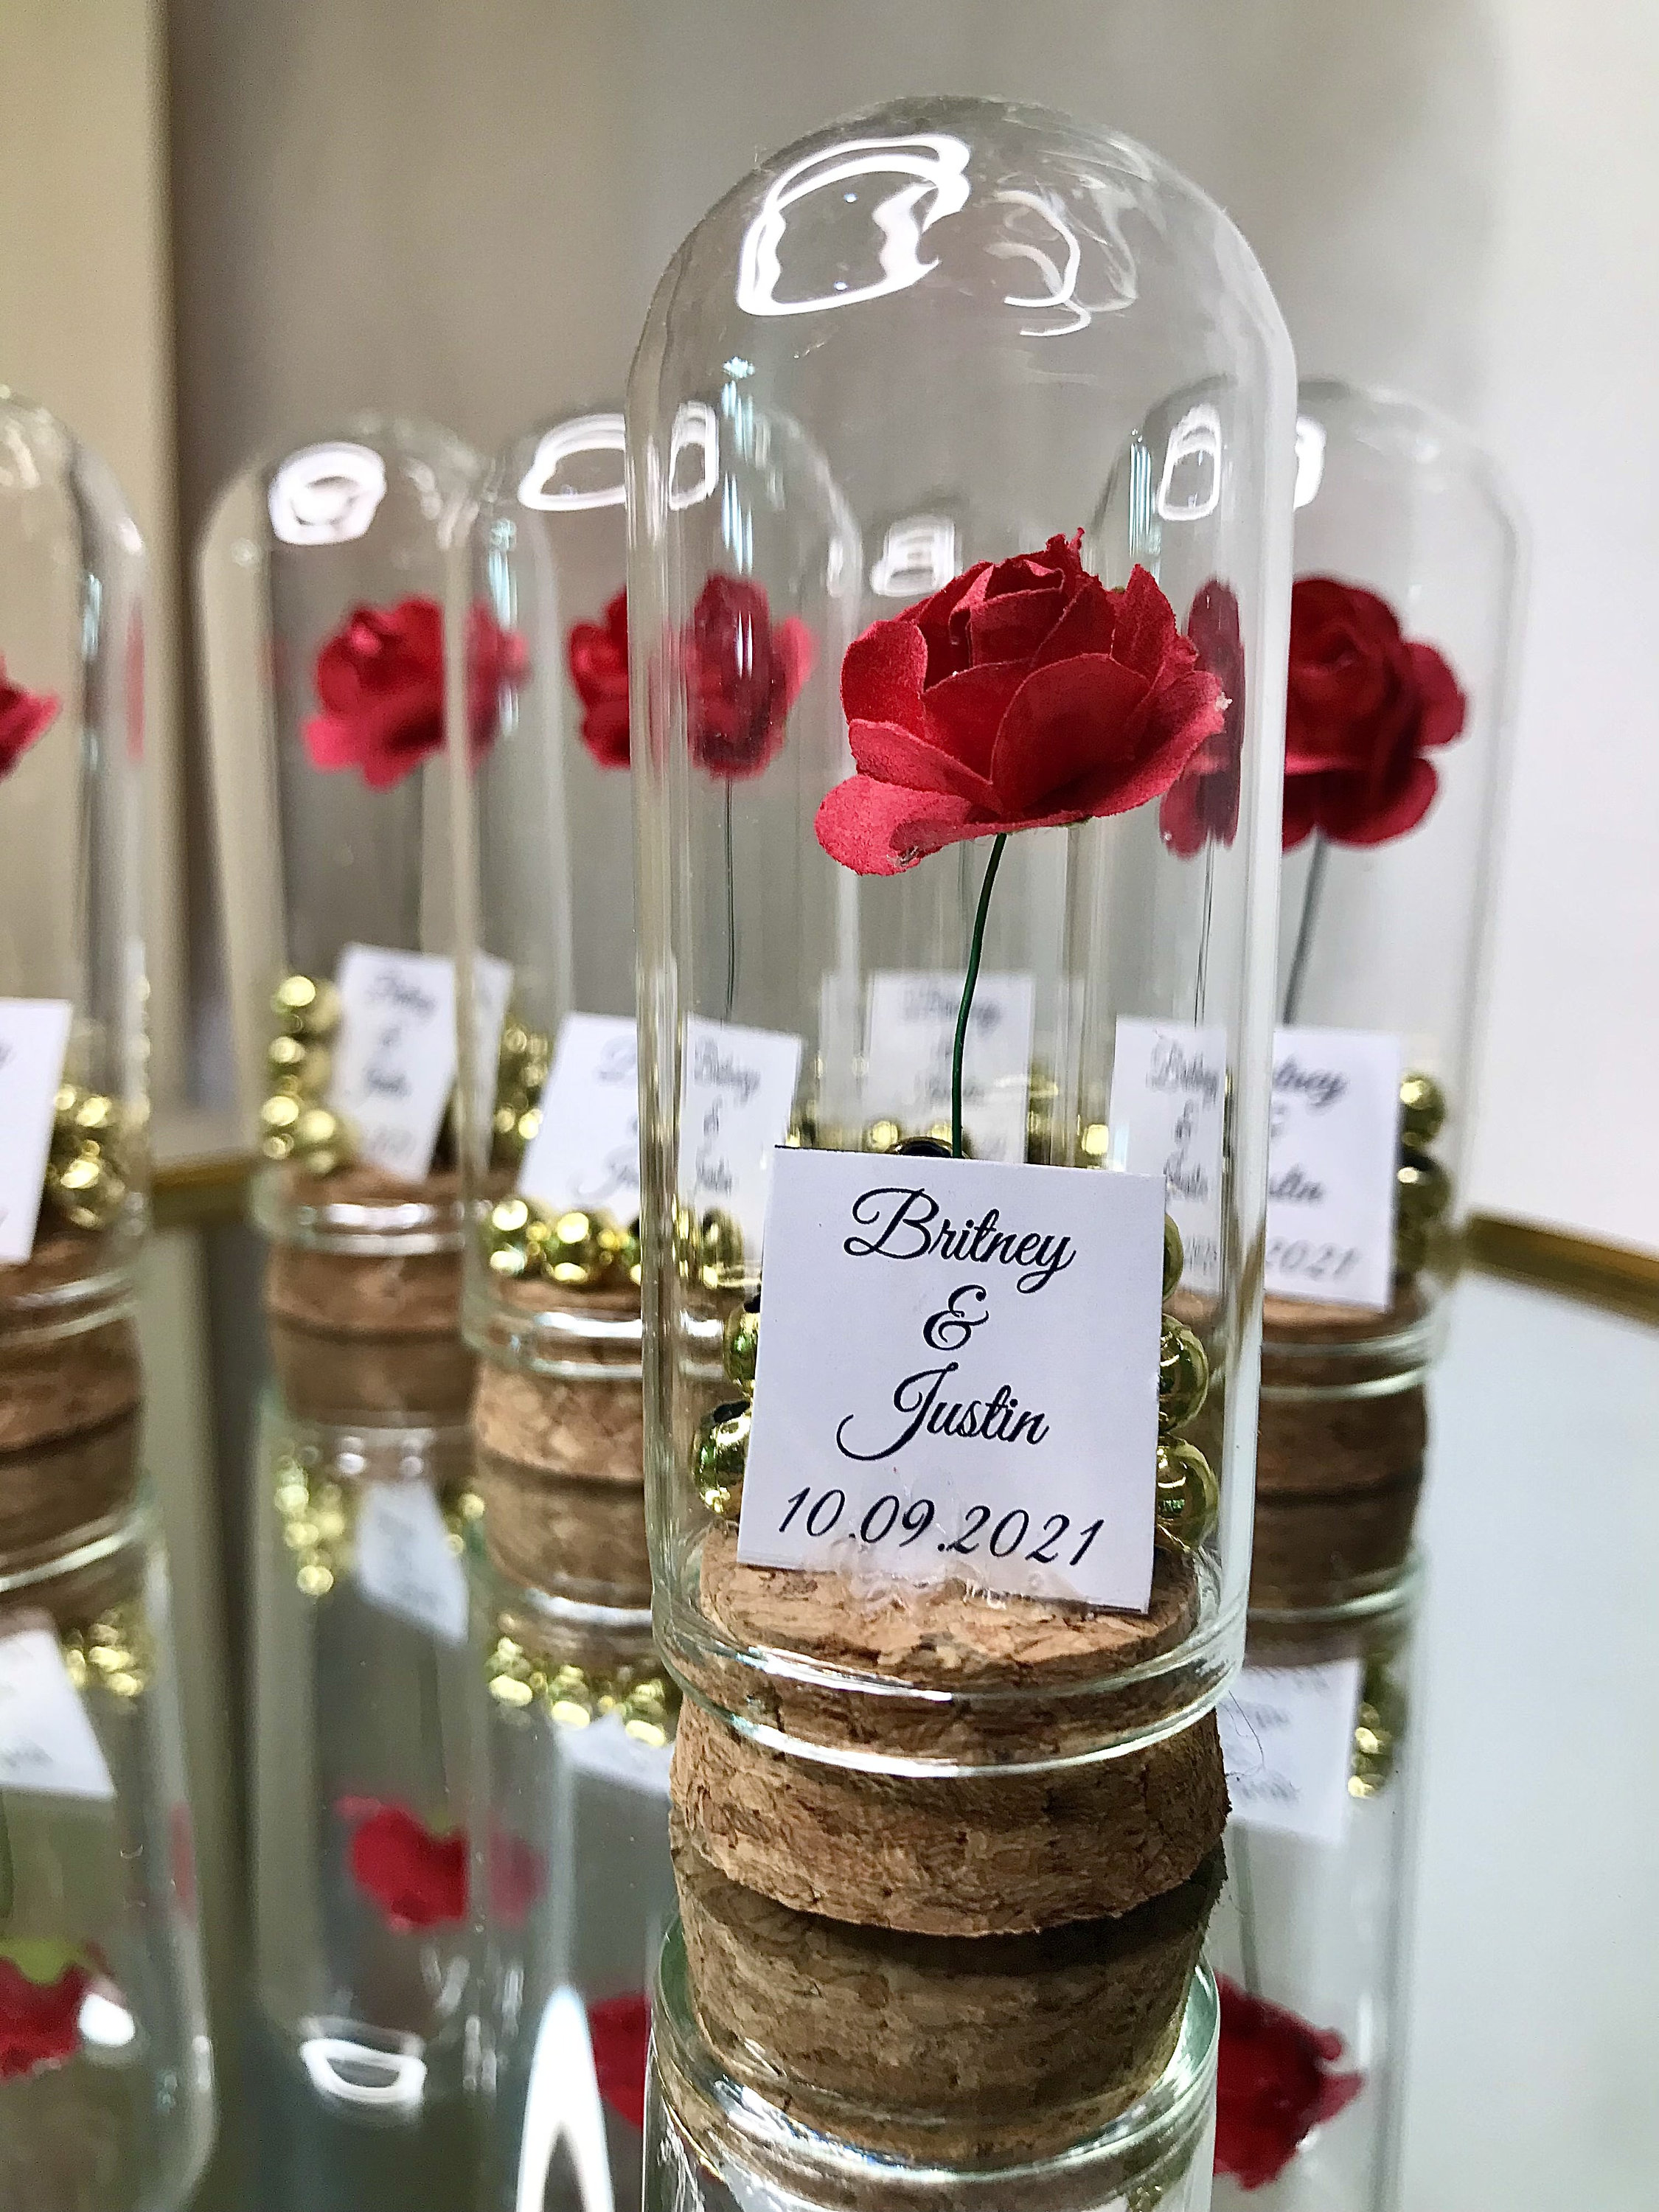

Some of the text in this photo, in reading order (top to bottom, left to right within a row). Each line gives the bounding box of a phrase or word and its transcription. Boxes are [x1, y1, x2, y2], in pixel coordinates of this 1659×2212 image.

[844, 1187, 1077, 1293] Britney
[922, 1284, 990, 1351] &
[836, 1361, 1050, 1461] Justin
[778, 1486, 1105, 1566] 10.09.2021
